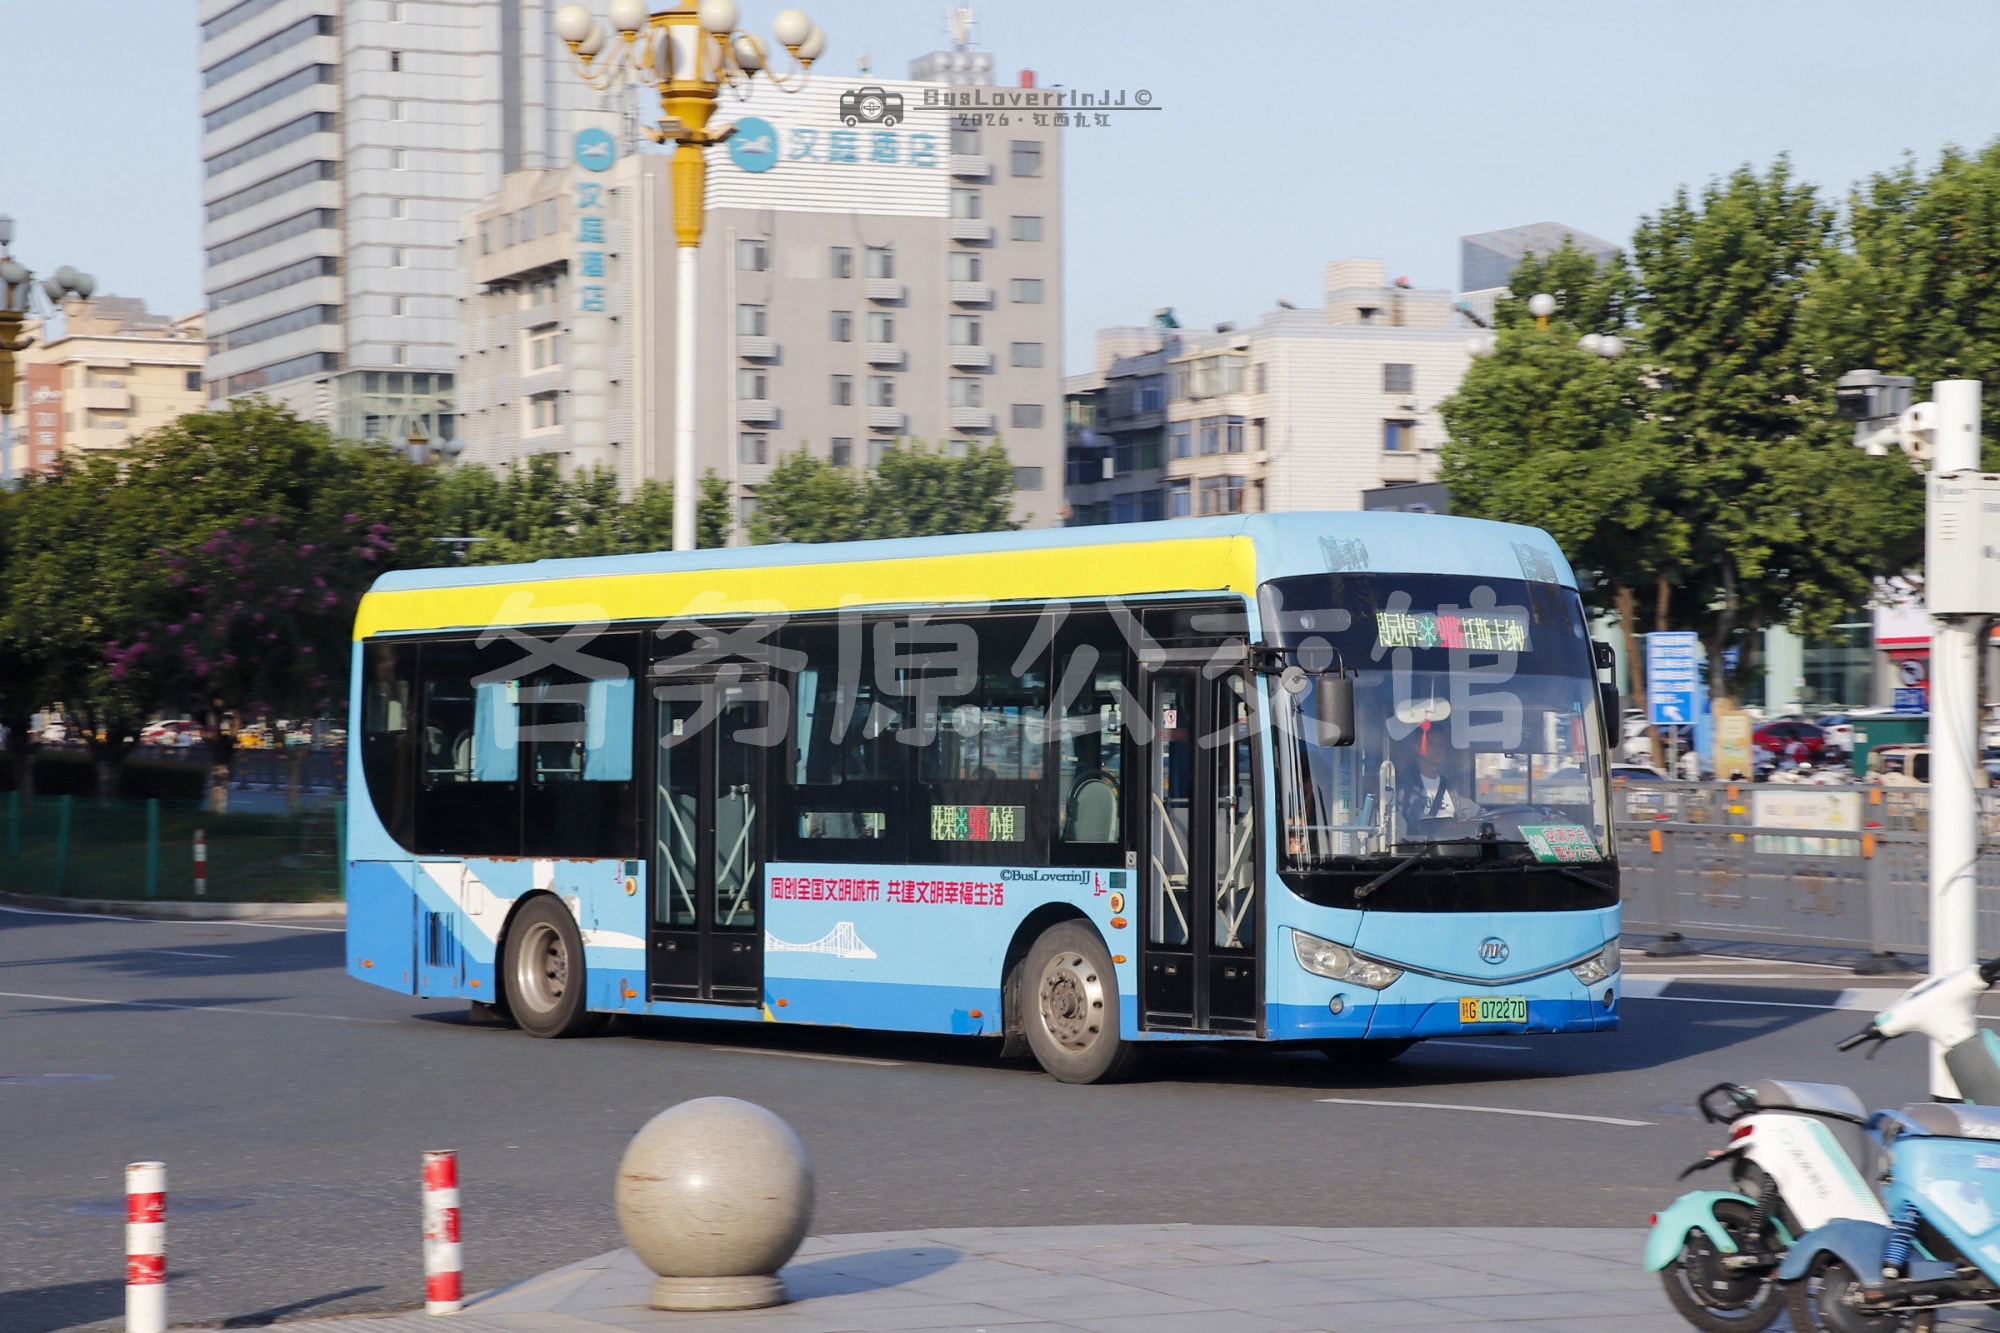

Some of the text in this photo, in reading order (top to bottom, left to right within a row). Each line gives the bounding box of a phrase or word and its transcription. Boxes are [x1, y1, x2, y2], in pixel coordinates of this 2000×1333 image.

[770, 877, 1004, 906] 同创全国文明城市 共建文明幸福生活
[1481, 1000, 1525, 1019] 07227D
